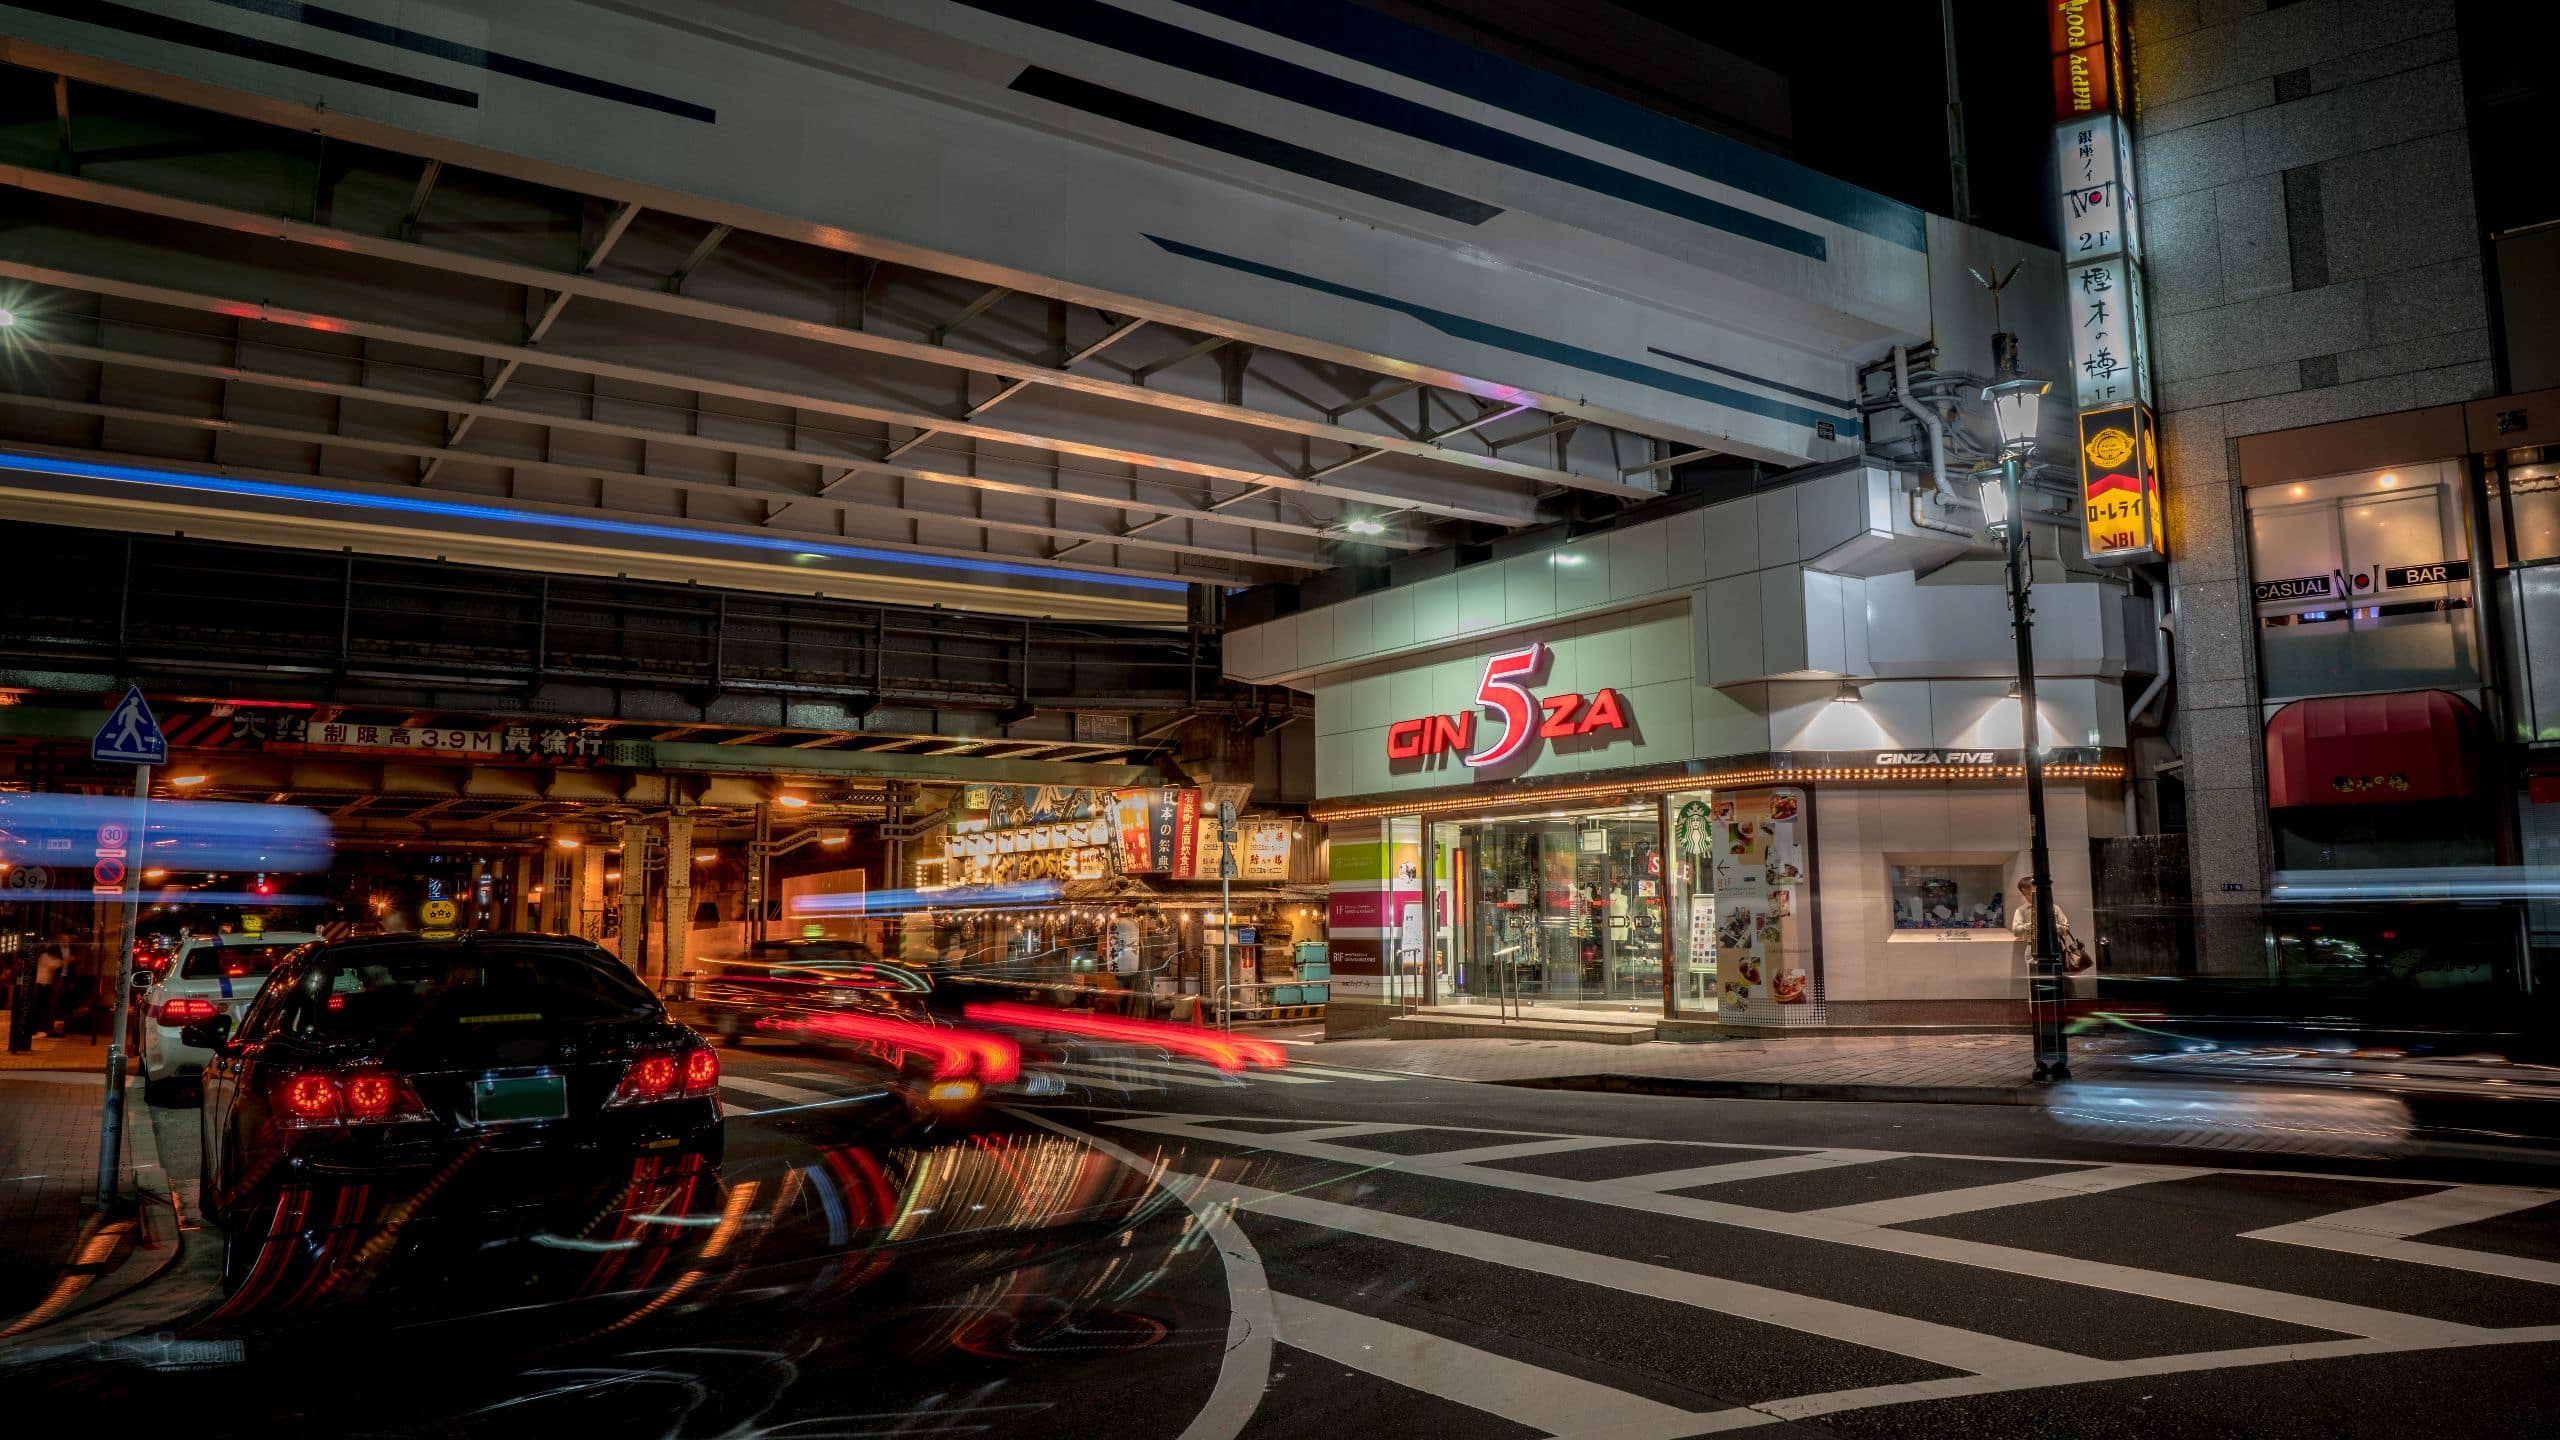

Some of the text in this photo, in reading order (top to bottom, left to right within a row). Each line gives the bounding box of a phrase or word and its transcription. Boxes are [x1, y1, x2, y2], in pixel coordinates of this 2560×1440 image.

[2070, 53, 2091, 111] HAPPY
[2078, 130, 2094, 181] 銀座ノイ
[2080, 231, 2110, 251] 2F
[2095, 386, 2116, 400] 1F
[2088, 500, 2143, 522] ローレライ
[2255, 579, 2329, 599] CASUAL
[2406, 566, 2447, 584] BAR
[1876, 752, 1994, 765] GINZA FIVE
[104, 828, 121, 841] 30
[1157, 791, 1173, 870] 日本の祭典
[1180, 793, 1195, 876] 有楽町産直飲食街
[1336, 905, 1344, 915] 1F
[1333, 952, 1344, 962] B1F
